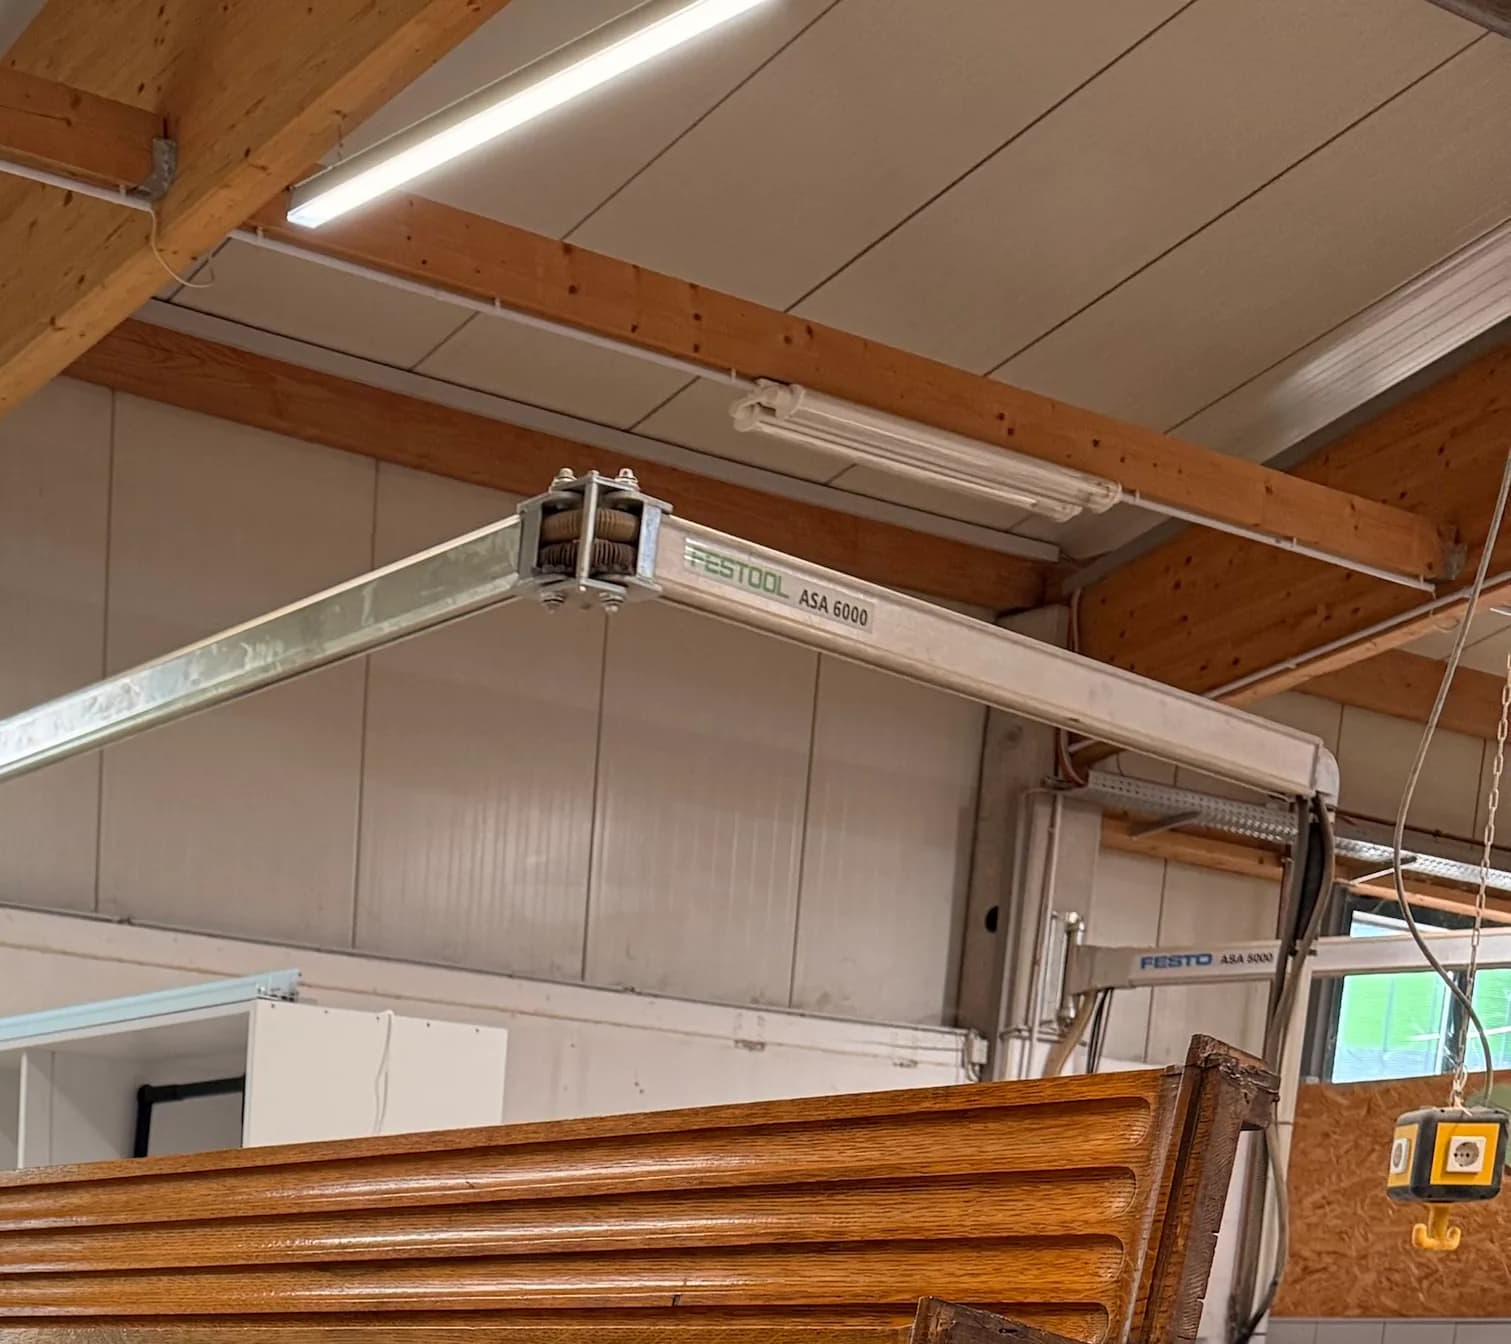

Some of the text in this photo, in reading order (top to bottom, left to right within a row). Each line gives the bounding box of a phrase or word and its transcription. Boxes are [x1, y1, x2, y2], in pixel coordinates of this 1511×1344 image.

[689, 545, 869, 627] FESTOOL ASA 6000
[1140, 953, 1213, 970] FESTO
[1220, 954, 1244, 966] ASA
